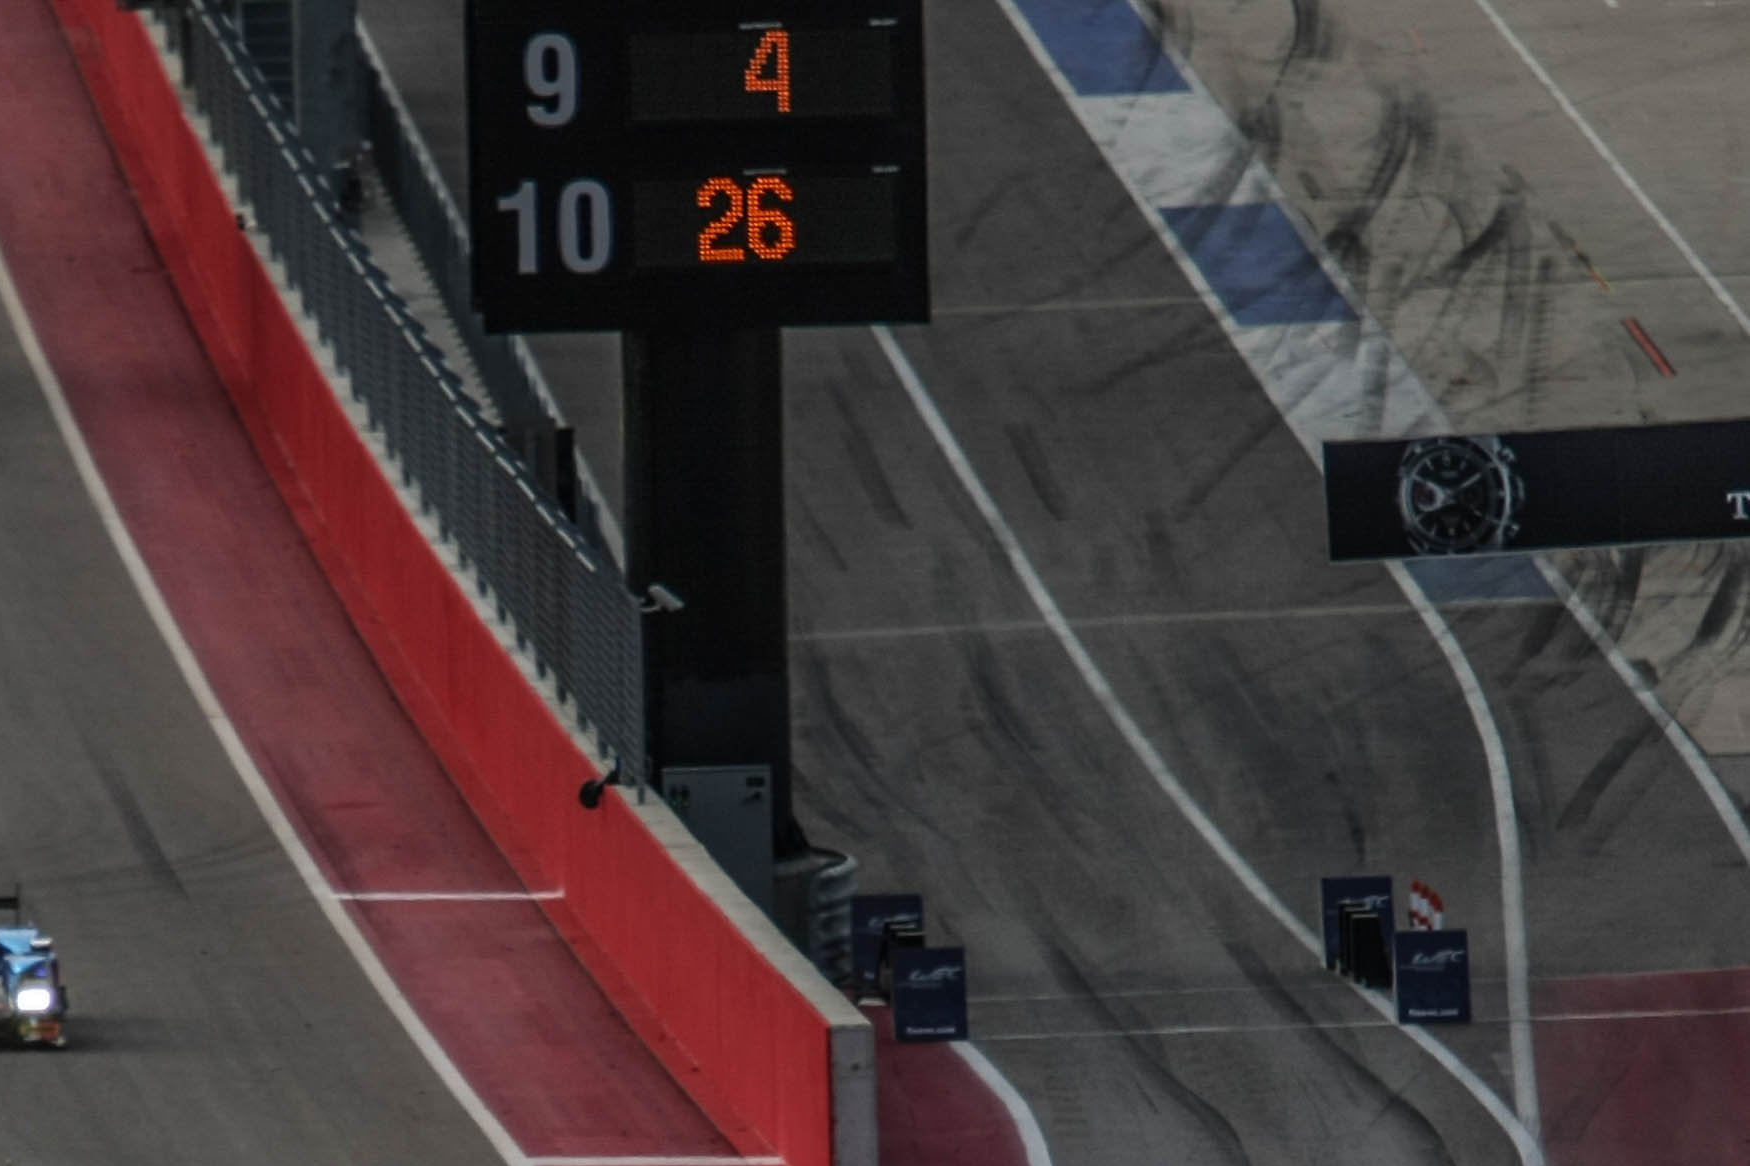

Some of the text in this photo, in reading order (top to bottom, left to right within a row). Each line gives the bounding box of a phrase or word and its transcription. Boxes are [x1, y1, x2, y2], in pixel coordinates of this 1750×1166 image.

[523, 32, 578, 128] 9
[744, 29, 791, 113] 4
[496, 178, 613, 275] 10
[696, 176, 795, 263] 26
